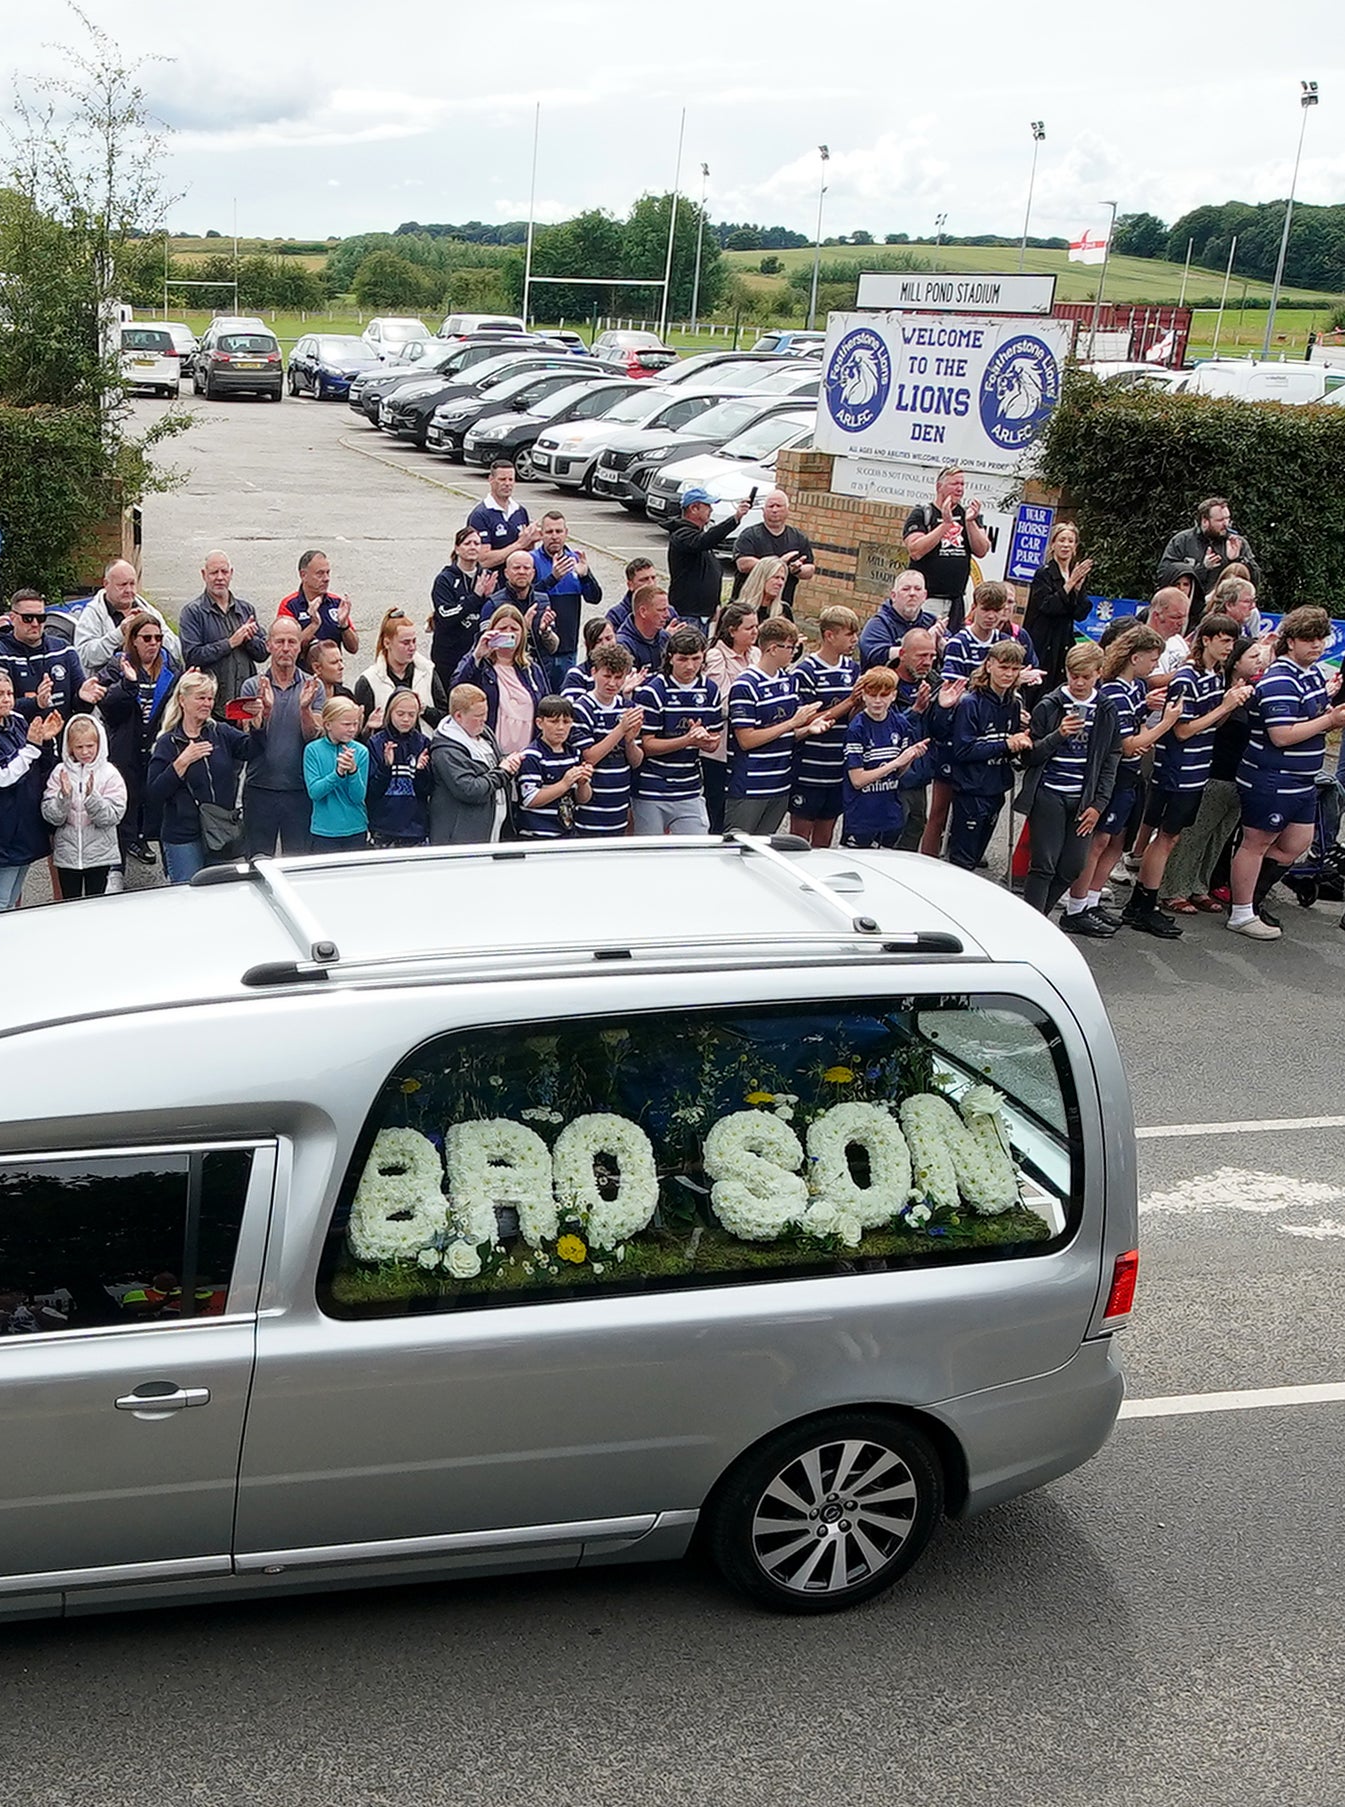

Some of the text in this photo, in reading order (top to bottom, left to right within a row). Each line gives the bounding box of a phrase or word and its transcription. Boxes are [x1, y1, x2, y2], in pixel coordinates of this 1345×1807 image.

[900, 282, 1001, 304] MILL POND STADIUM
[901, 327, 984, 348] WELCOME
[909, 356, 968, 377] TO THE
[895, 384, 971, 416] LIONS
[910, 422, 946, 443] DEN
[1026, 508, 1047, 522] WAR
[1017, 521, 1049, 537] HORSE
[1020, 536, 1041, 550] CAR
[1015, 549, 1041, 565] PARK
[701, 1091, 1024, 1243] SON
